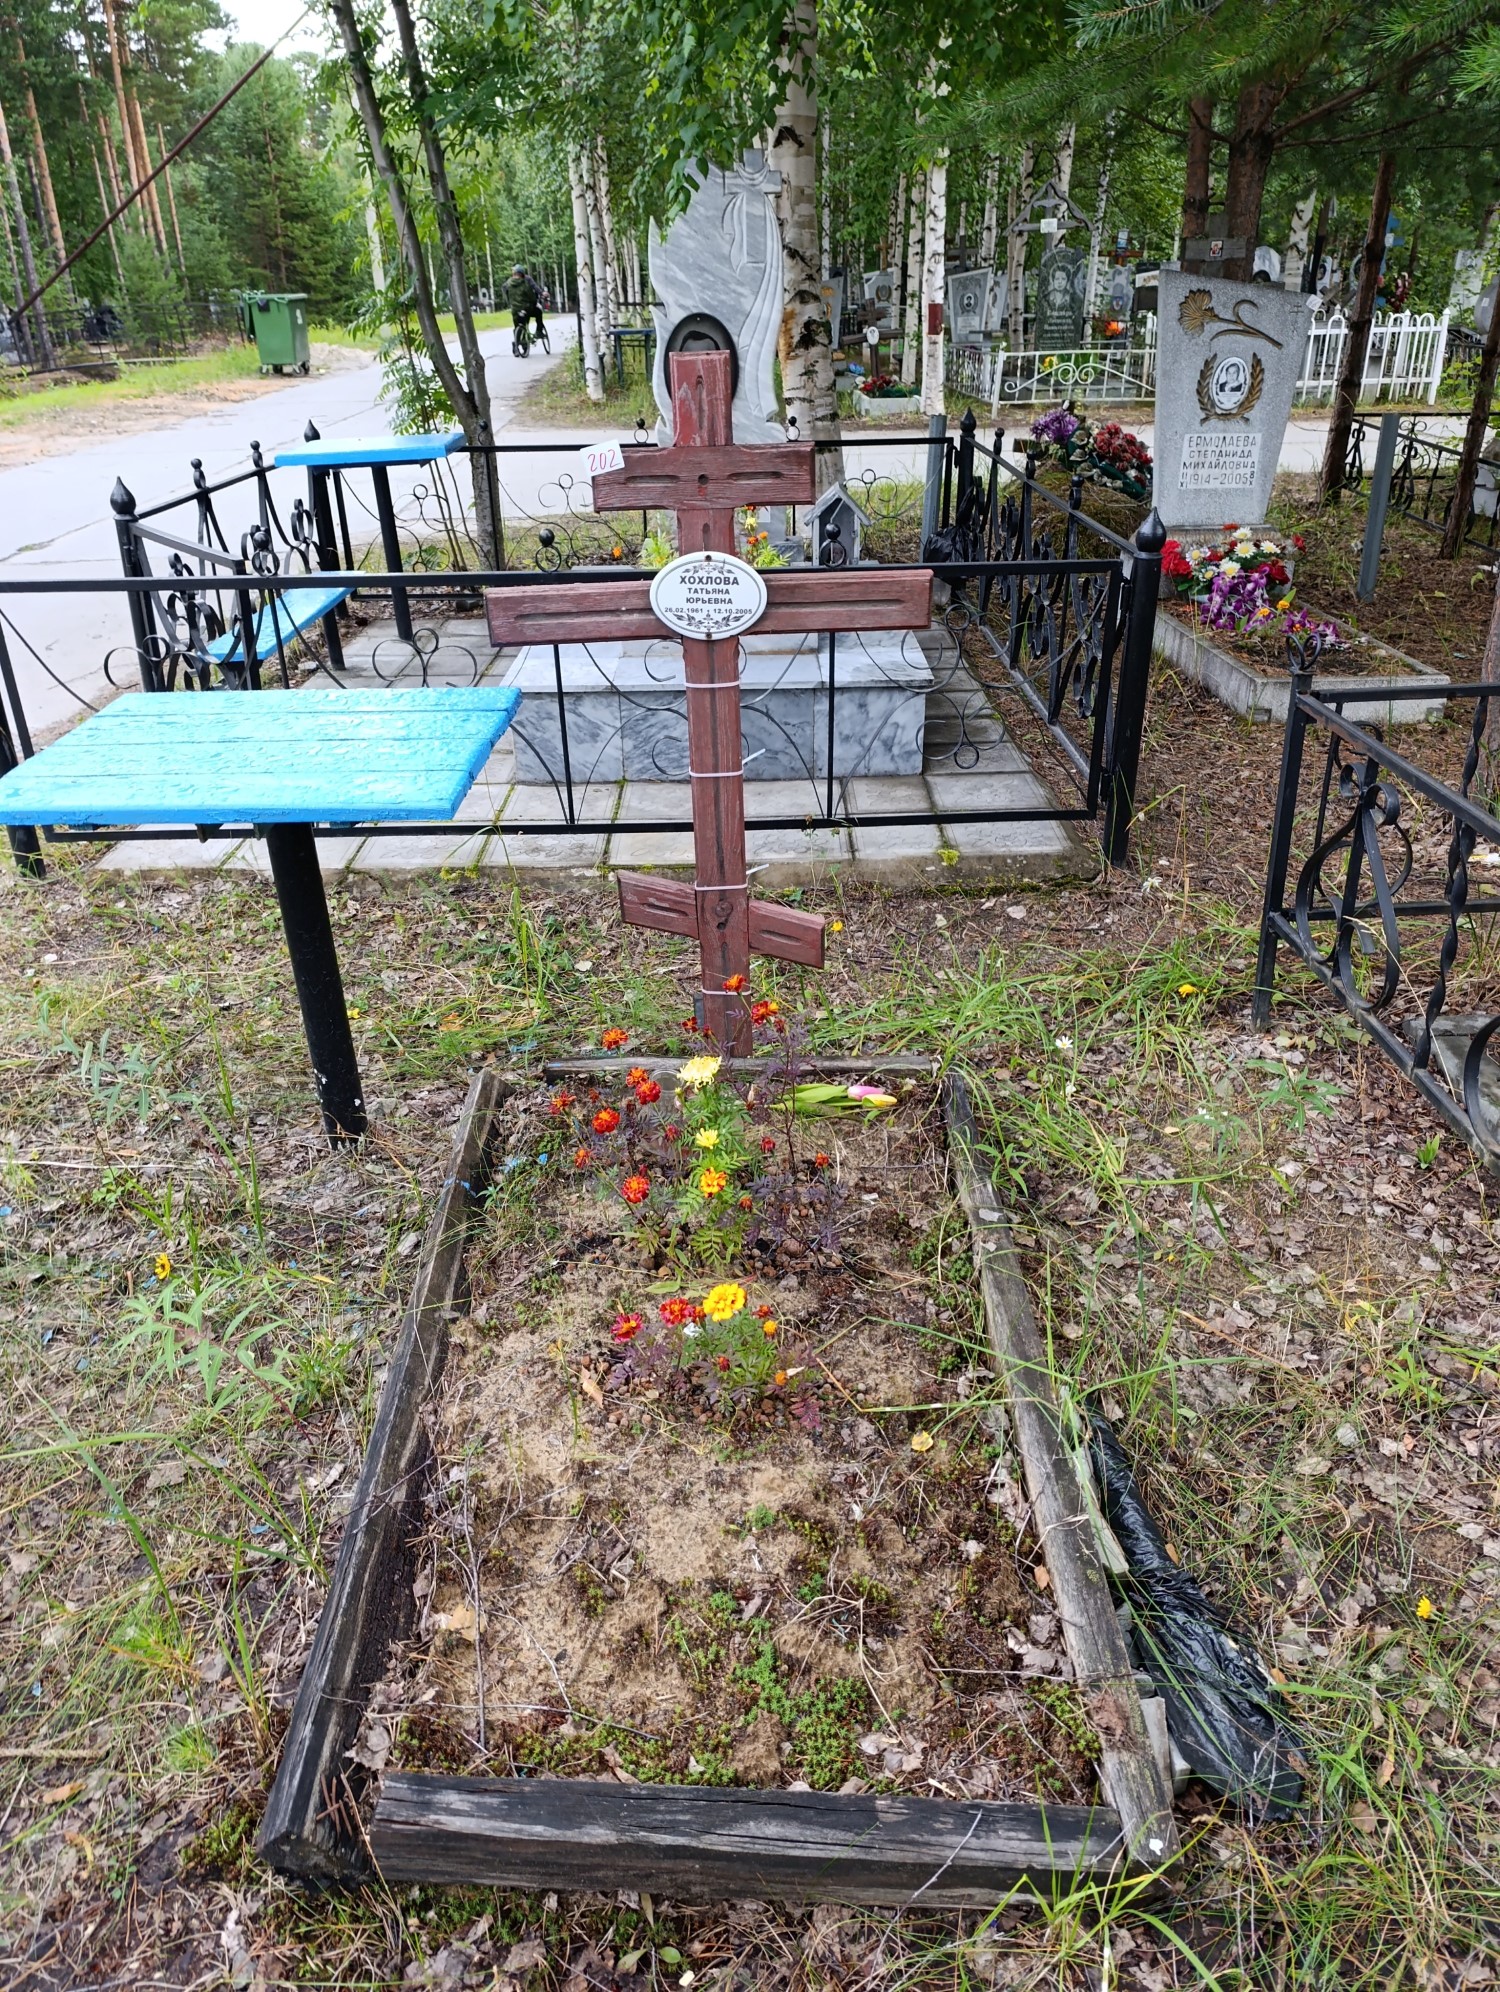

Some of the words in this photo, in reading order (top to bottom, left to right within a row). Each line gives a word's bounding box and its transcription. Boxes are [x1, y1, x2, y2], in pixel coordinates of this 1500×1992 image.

[1188, 435, 1257, 448] ЕРМОЛАЕВА
[1189, 449, 1253, 459] СТЕПАНИДА
[587, 449, 621, 472] 202
[1182, 459, 1256, 470] МИХАЙЛОВНА
[679, 575, 740, 586] ХОХЛОВА
[687, 587, 731, 596] ТАТЬЯНА
[685, 597, 733, 605] ЮРЬЕВНА
